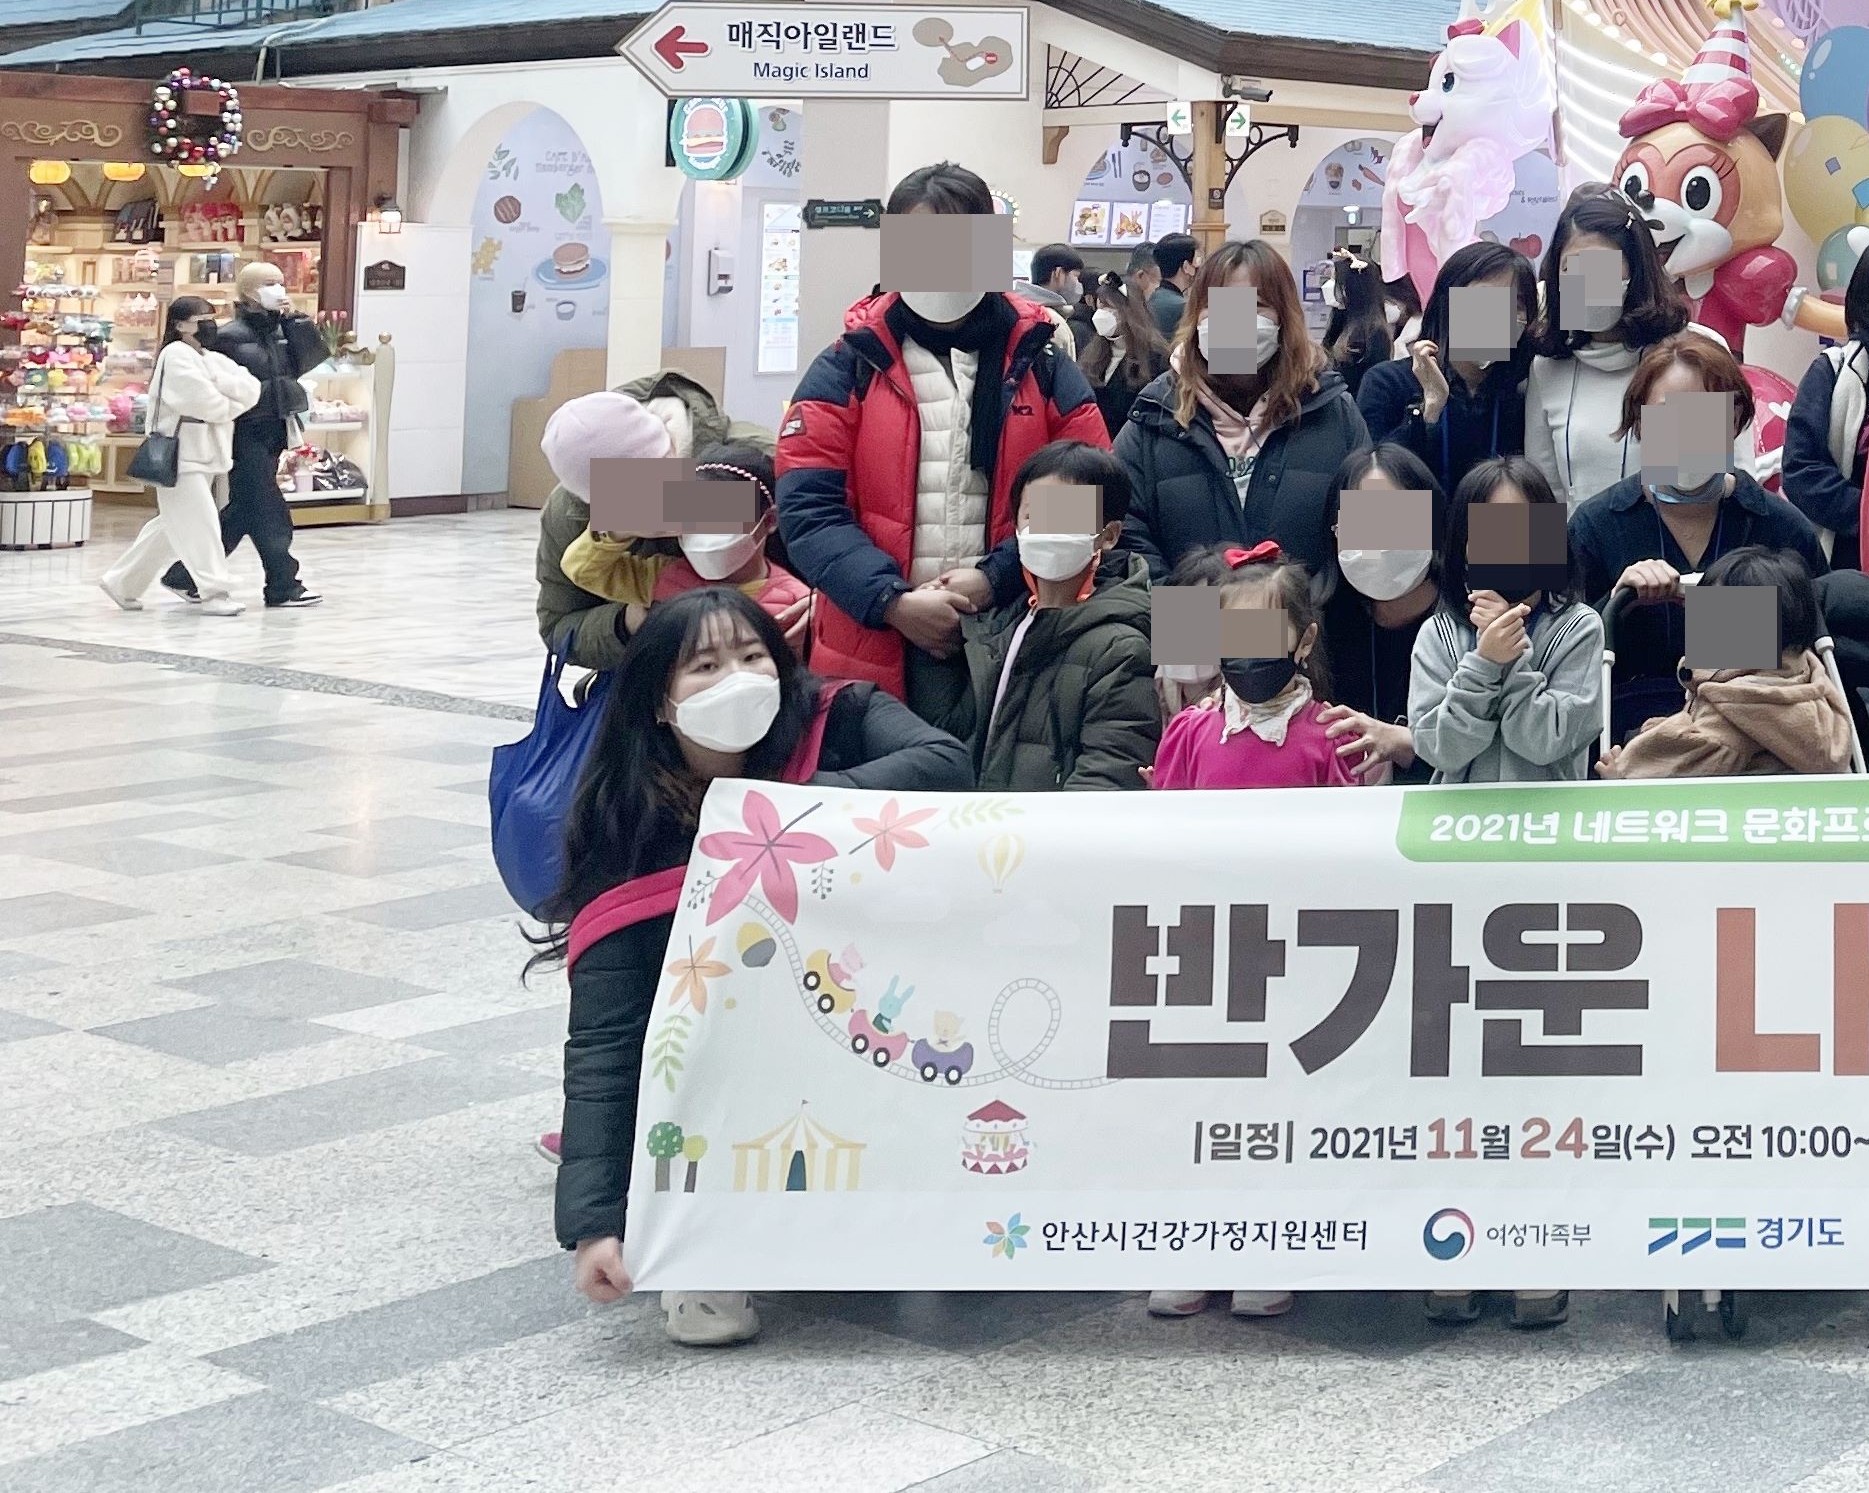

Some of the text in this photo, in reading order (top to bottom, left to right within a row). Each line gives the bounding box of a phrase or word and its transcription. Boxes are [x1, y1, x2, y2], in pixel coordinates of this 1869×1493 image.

[726, 18, 897, 53] 매직아일랜드
[752, 61, 869, 82] Magic Island
[1430, 811, 1558, 845] 2021년
[1573, 808, 1729, 844] 네트워크
[1106, 903, 1650, 1078] 반가운
[1309, 1125, 1418, 1160] 2021년
[1427, 1117, 1510, 1160] 11월
[1520, 1117, 1675, 1161] 24일(수)
[1691, 1123, 1752, 1160] 오전
[1042, 1219, 1368, 1252] 안산시건강가정지원센터
[1486, 1222, 1592, 1248] 여성가족부
[1757, 1217, 1845, 1249] 경기도
